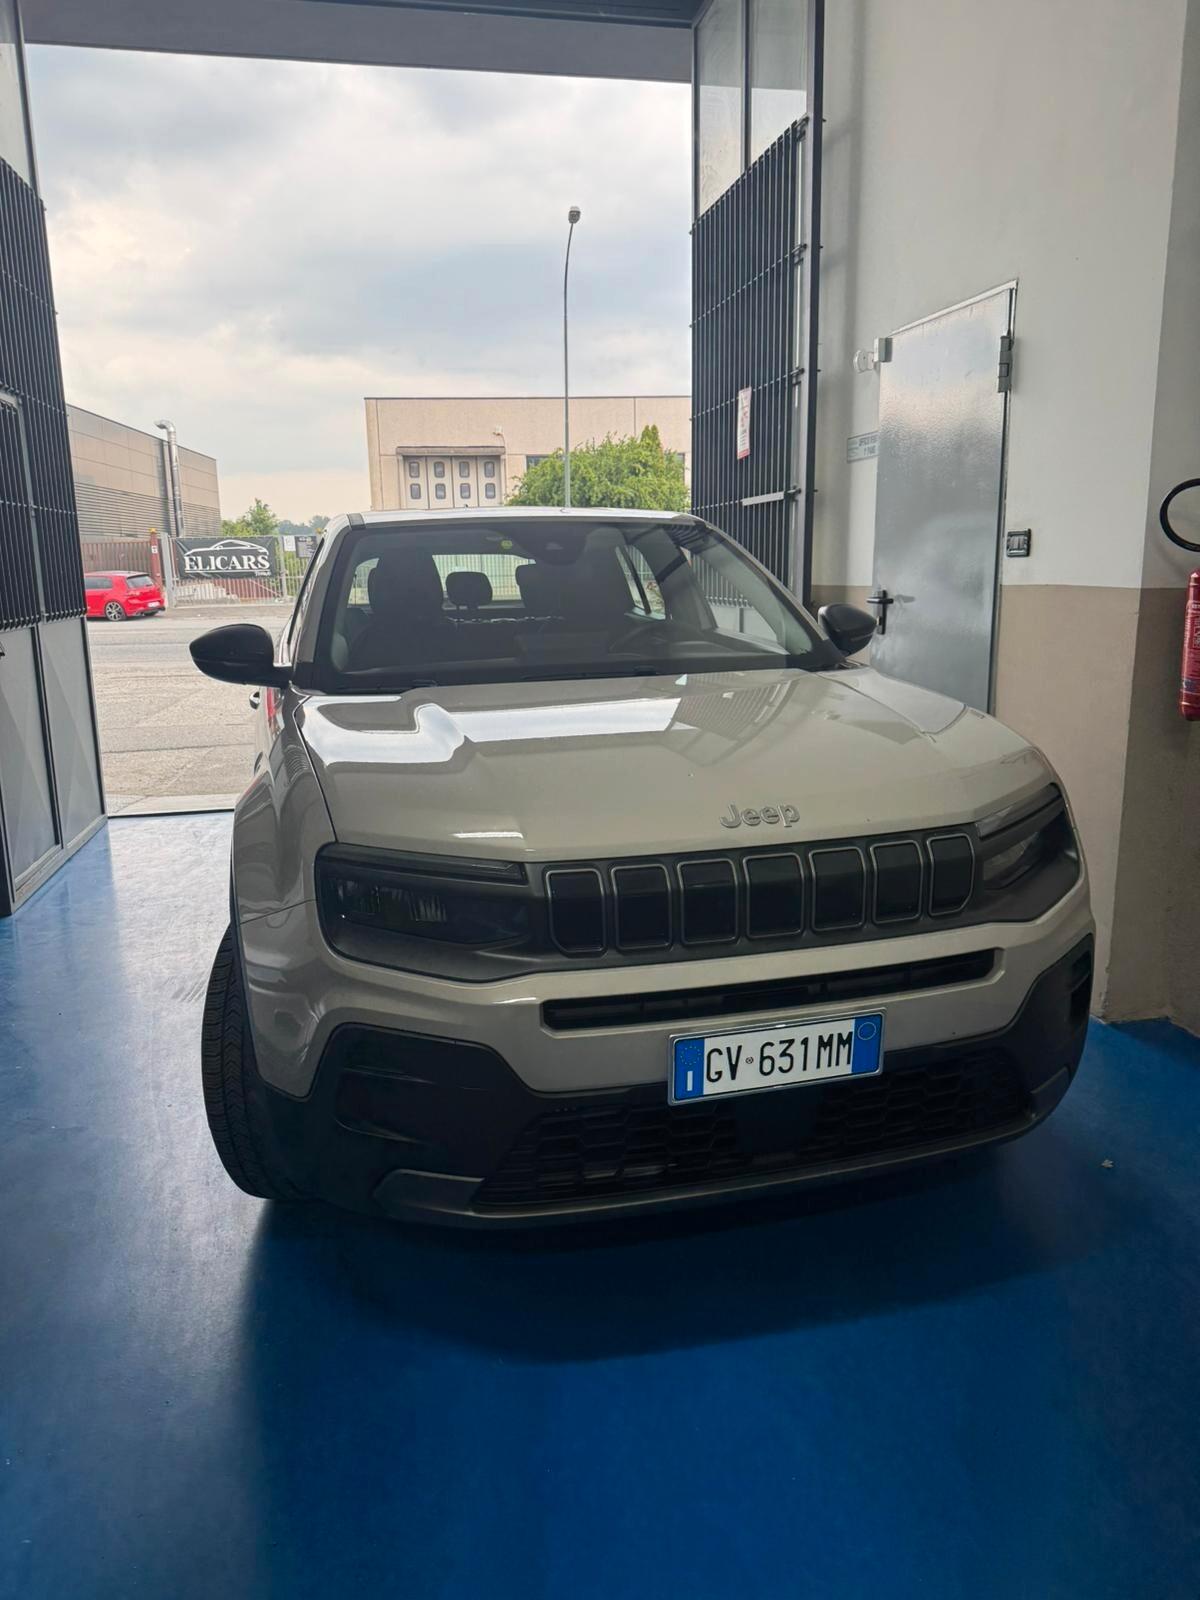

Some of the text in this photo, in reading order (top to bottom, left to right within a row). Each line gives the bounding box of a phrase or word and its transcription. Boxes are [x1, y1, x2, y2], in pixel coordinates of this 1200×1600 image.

[184, 554, 270, 571] ELICARS
[720, 804, 800, 828] Jeep
[706, 1045, 743, 1083] GV
[759, 1031, 853, 1076] 631MM
